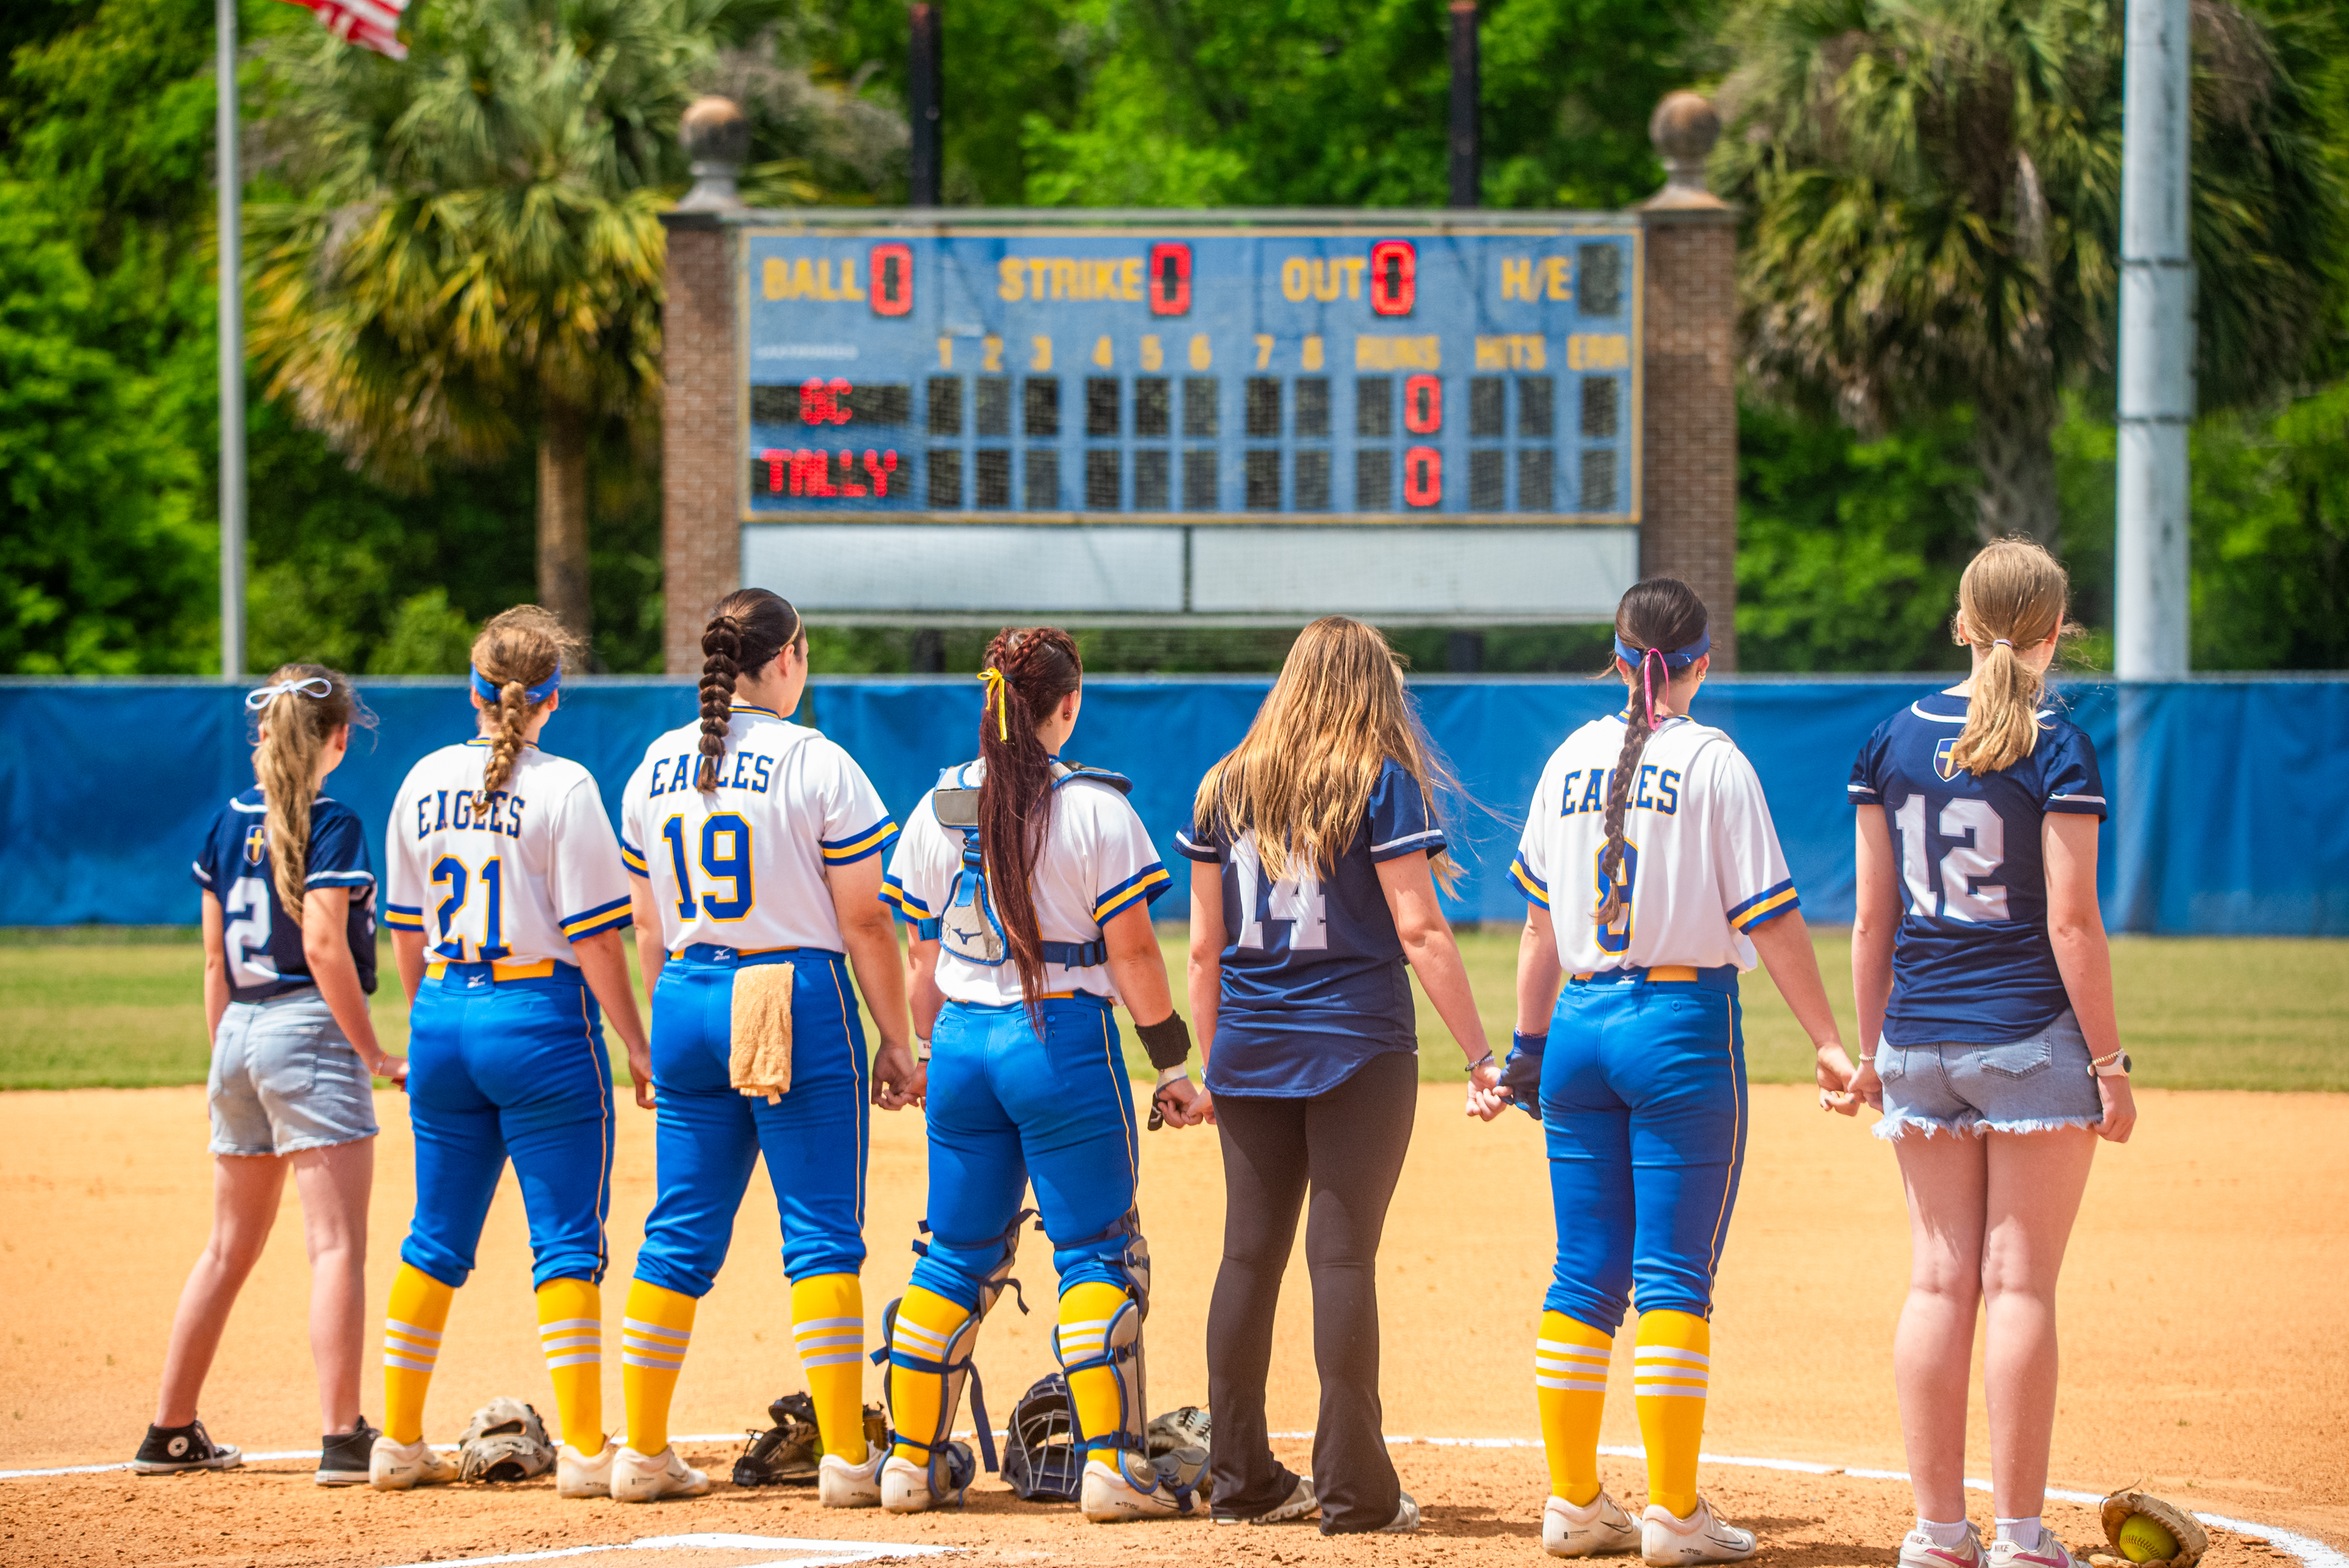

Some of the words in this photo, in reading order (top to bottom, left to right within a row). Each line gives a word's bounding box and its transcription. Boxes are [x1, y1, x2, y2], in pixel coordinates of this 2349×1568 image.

[762, 257, 865, 302] BALL
[869, 242, 913, 316] 0
[998, 257, 1144, 302] STRIKE
[1149, 242, 1193, 316] 0
[1281, 256, 1367, 302] OUT
[1371, 240, 1416, 316] 0
[1502, 255, 1573, 302] H/E
[937, 336, 953, 369] 1
[982, 334, 1002, 371] 2
[1031, 335, 1053, 371] 3
[1092, 335, 1114, 369] 4
[1140, 333, 1164, 371] 5
[1189, 333, 1213, 371] 6
[1255, 334, 1275, 370] 7
[1405, 374, 1441, 434] 0
[759, 448, 898, 498] TALLY
[1404, 446, 1441, 507] 0
[1560, 764, 1681, 818] EAES
[661, 811, 756, 923] 19
[1230, 829, 1328, 950] 14
[1894, 793, 2011, 922] 12
[224, 876, 279, 988] 2
[429, 853, 515, 962] 21
[1994, 1543, 2010, 1553] NIKE
